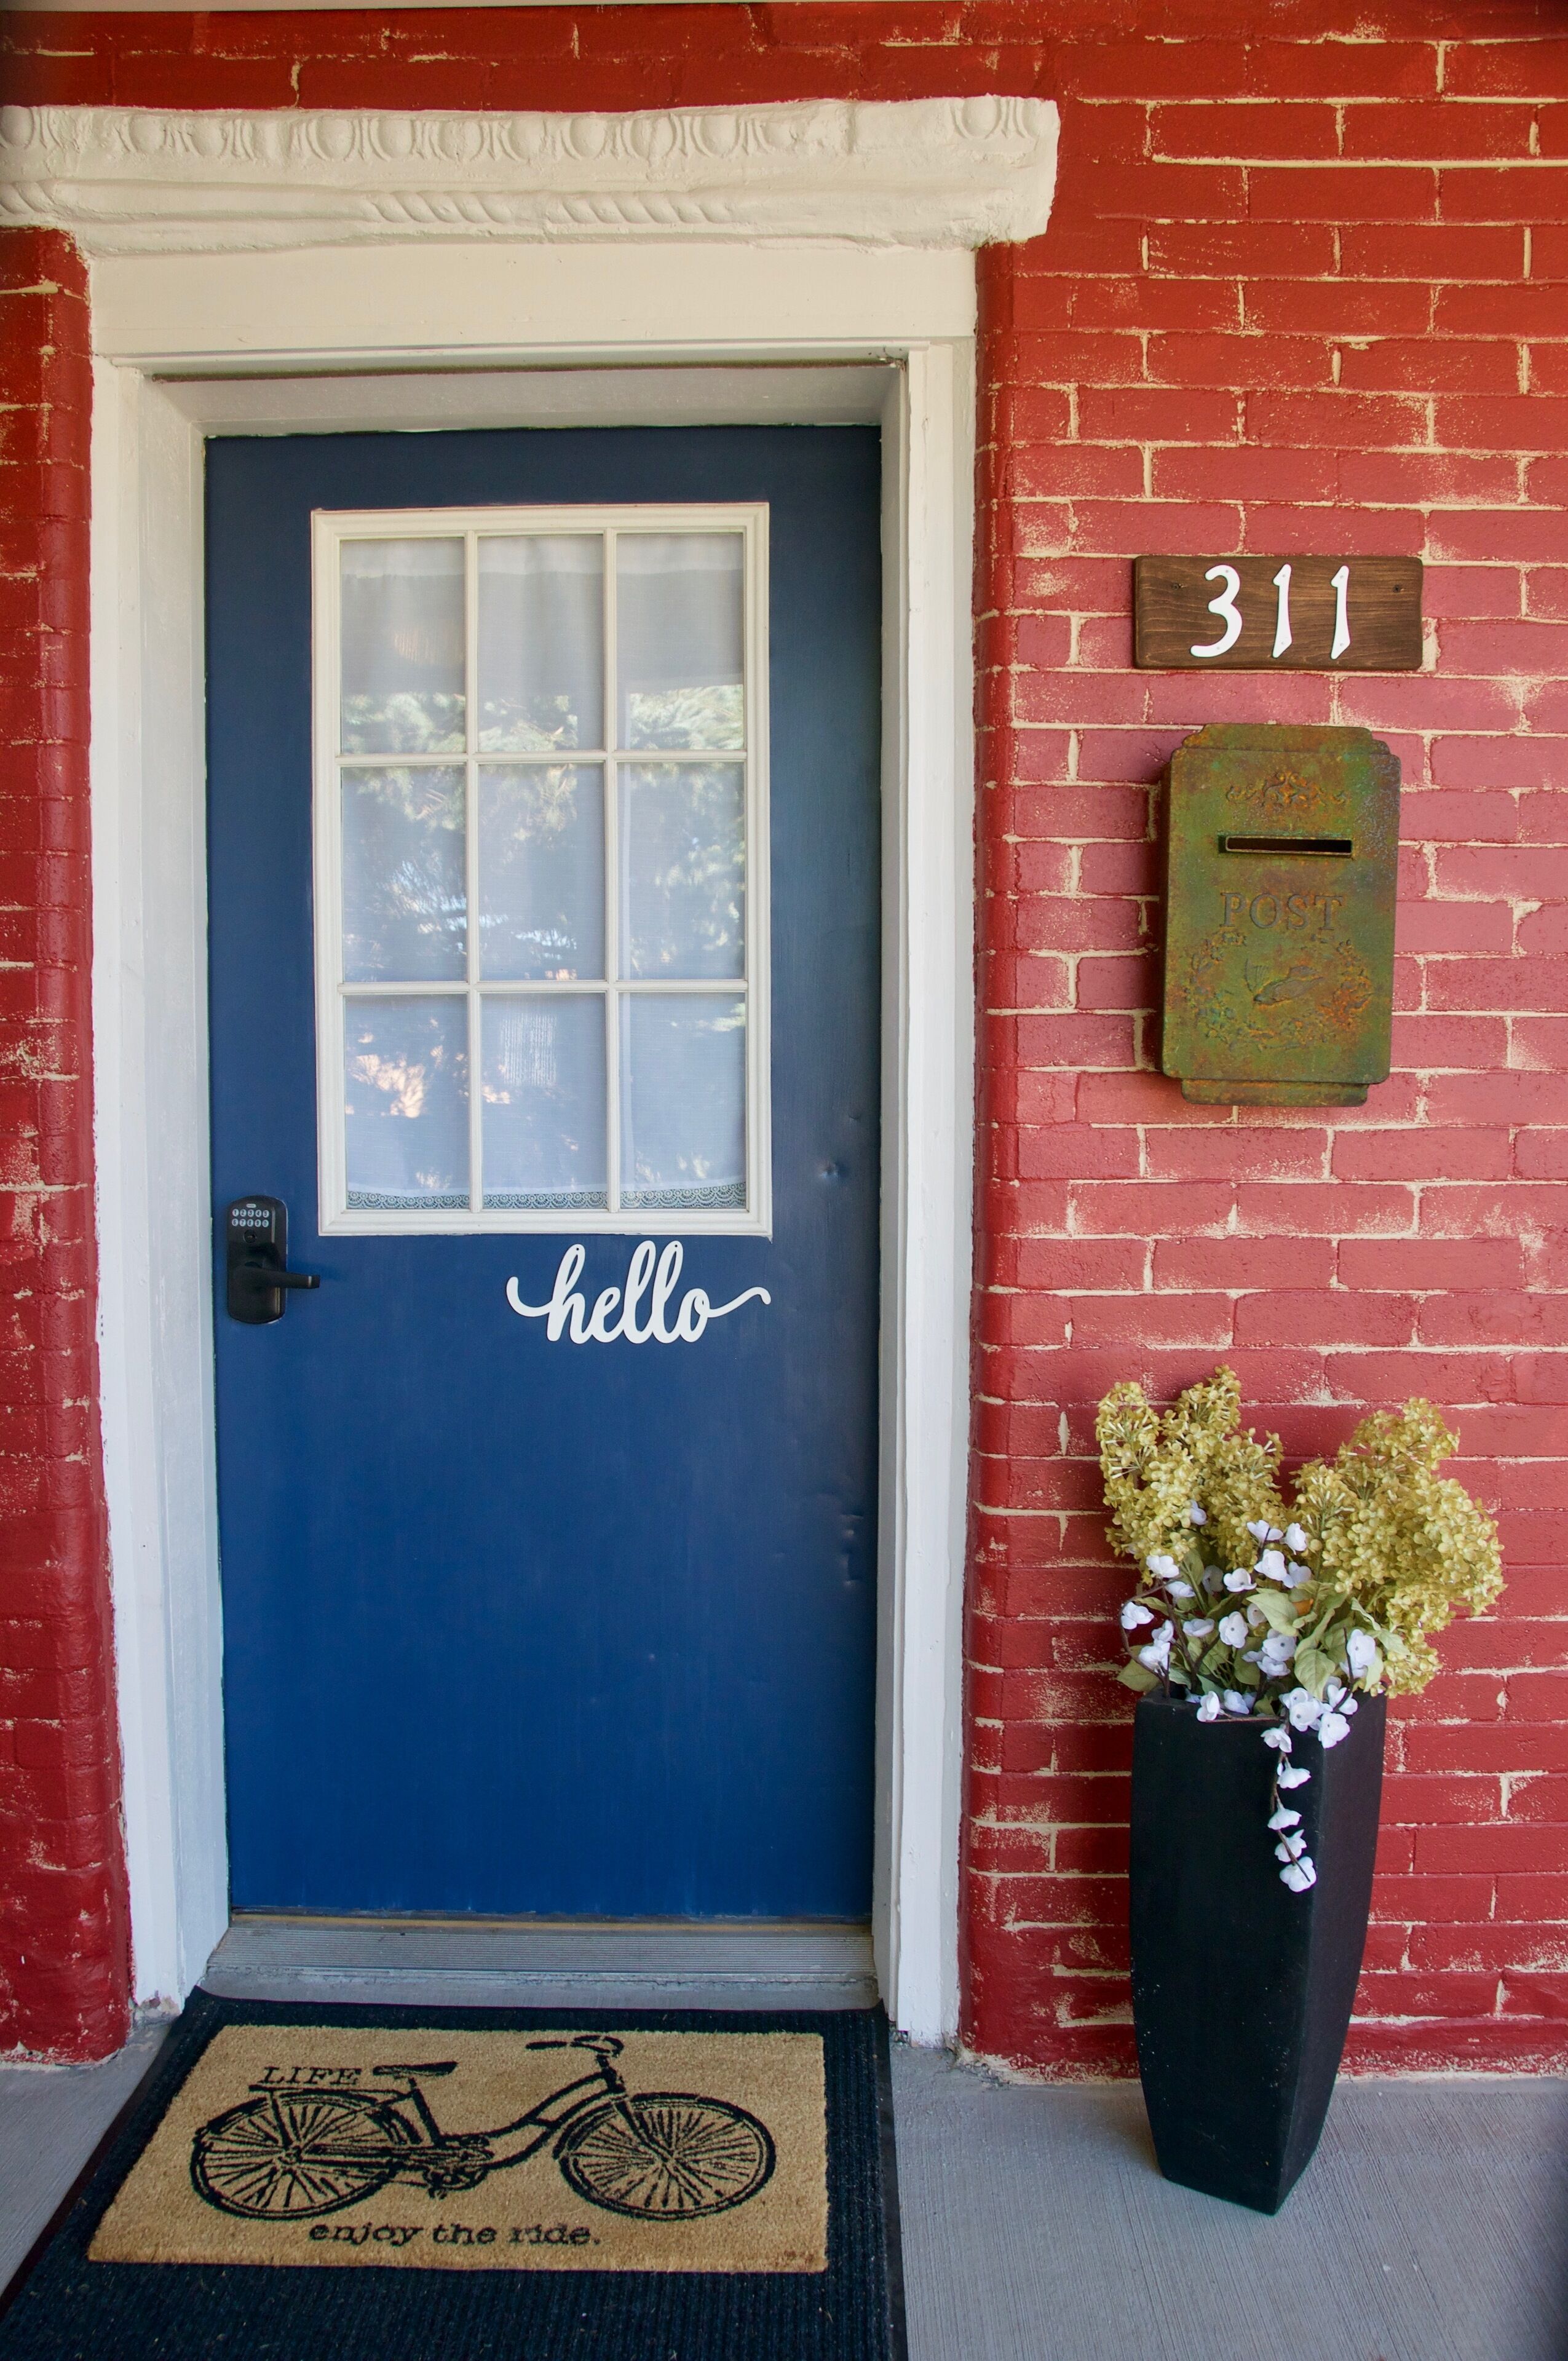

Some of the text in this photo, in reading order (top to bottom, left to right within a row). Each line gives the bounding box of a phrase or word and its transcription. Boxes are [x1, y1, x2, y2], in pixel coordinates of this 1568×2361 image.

[1190, 564, 1350, 660] 311
[1221, 892, 1344, 931] POST
[506, 1240, 771, 1344] hello
[257, 2066, 362, 2085] LIFE
[309, 2222, 600, 2247] enjoy the ride.
